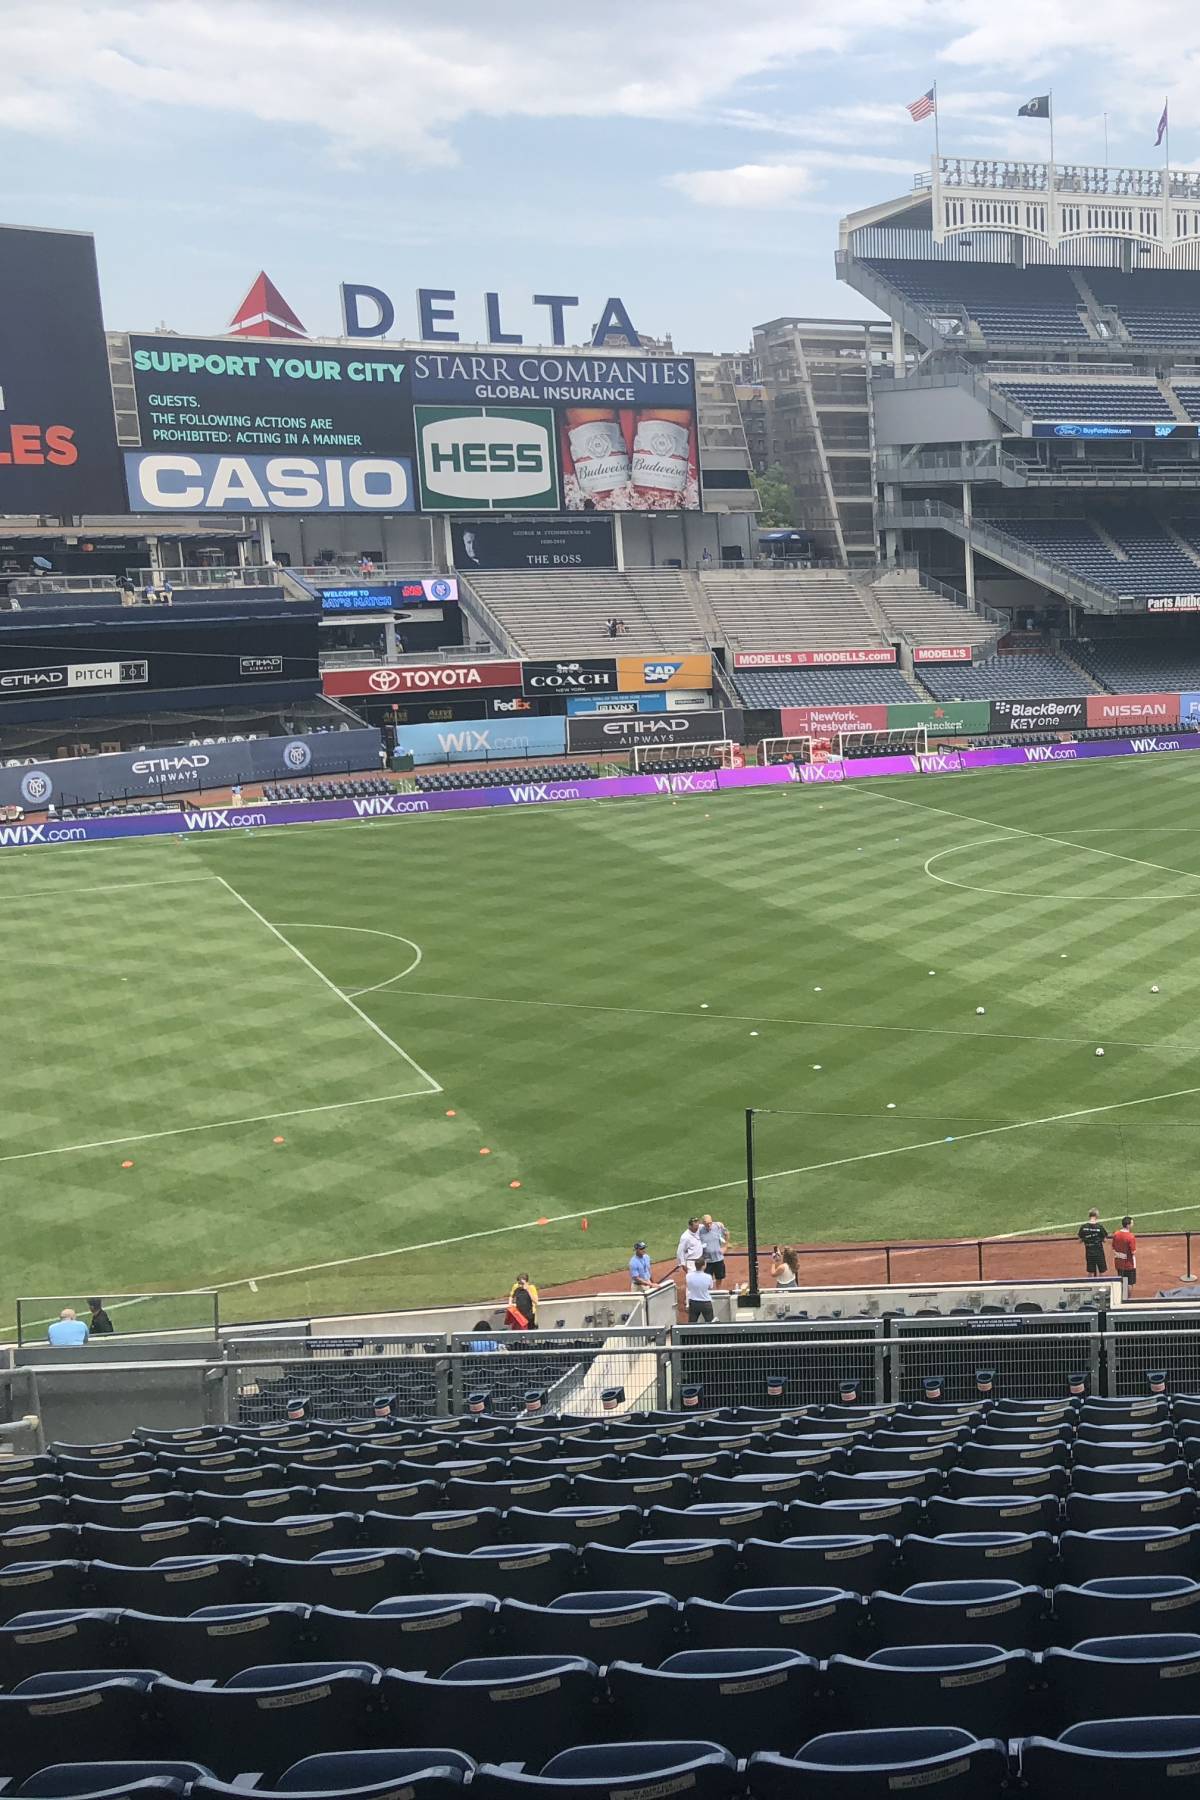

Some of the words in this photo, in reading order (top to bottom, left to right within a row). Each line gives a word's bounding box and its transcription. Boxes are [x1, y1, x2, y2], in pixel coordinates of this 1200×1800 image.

[340, 283, 641, 346] DELTA
[134, 350, 260, 377] SUPPORT
[266, 357, 342, 381] YOUR
[347, 362, 406, 382] CITY
[415, 355, 515, 381] STARR
[519, 359, 690, 385] COMPANIES
[475, 385, 540, 400] GLOBAL
[543, 386, 636, 401] INSURANCE
[151, 413, 177, 425] THE
[180, 414, 251, 427] FOLLOWING
[255, 416, 307, 429] ACTIONS
[310, 418, 333, 430] ARE
[153, 430, 232, 443] PROHIBITED:
[236, 432, 281, 444] ACTING
[285, 433, 298, 444] IN
[302, 434, 309, 445] A
[314, 434, 362, 446] MANNER
[1155, 427, 1171, 437] SAP
[431, 442, 544, 473] HESS
[138, 455, 408, 508] CASIO
[526, 555, 549, 564] THE
[553, 554, 582, 564] BOSS
[323, 590, 358, 598] WELCOME
[1147, 598, 1173, 608] Parts
[739, 653, 792, 665] MODELL'S
[813, 651, 890, 663] MODELLS.com
[919, 648, 966, 659] MODELL'S
[242, 658, 280, 667] ETIHAD
[1, 672, 63, 687] ETIHAD
[75, 668, 113, 681] PITCH
[402, 669, 482, 687] TOYOTA
[530, 673, 610, 687] COACH
[644, 666, 676, 681] SAP
[493, 698, 531, 711] FedEx
[1103, 703, 1166, 717] NISSAN
[810, 711, 859, 722] NewYork-
[603, 719, 689, 735] ETIHAD
[810, 721, 872, 732] Presbyterian
[917, 719, 963, 731] Heineken
[620, 734, 674, 745] AIRWAYS
[131, 754, 210, 774] ETIHAD
[148, 770, 198, 784] AIRWAYS
